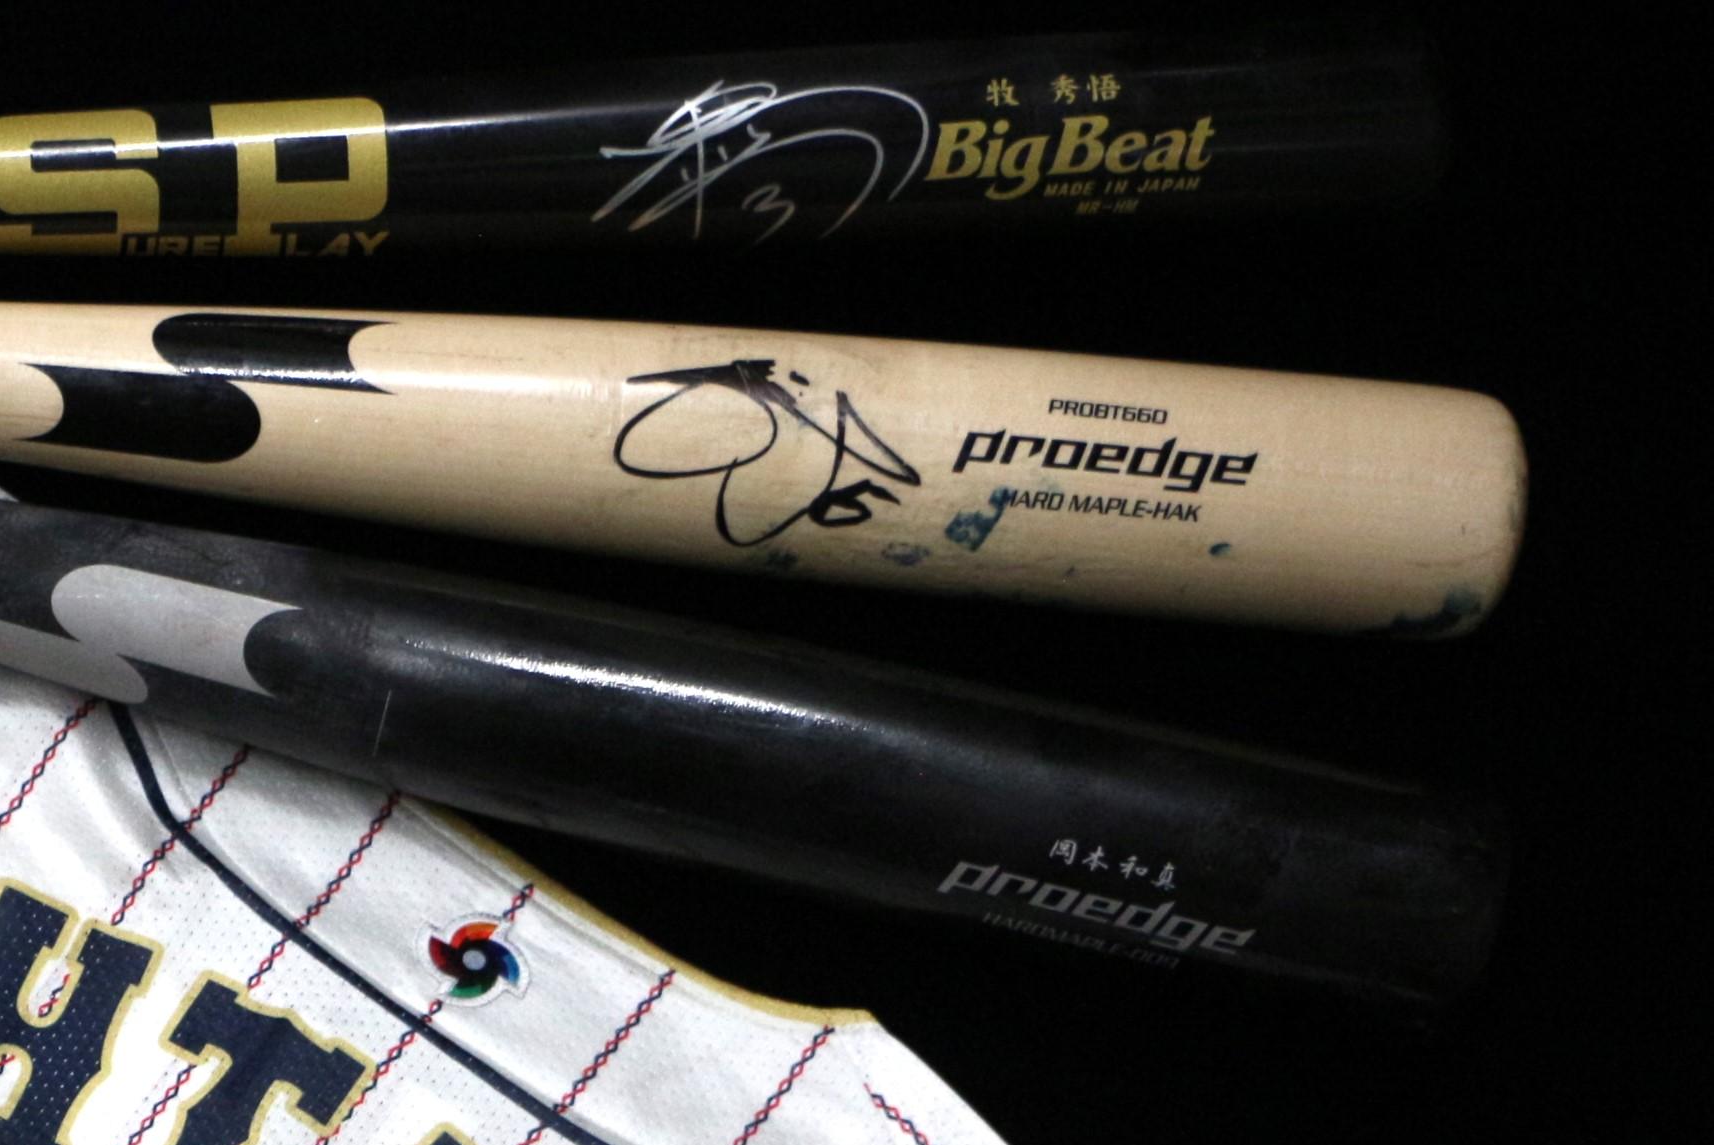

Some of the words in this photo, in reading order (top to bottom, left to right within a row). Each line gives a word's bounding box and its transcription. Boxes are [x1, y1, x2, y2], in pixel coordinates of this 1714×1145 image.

[1042, 179, 1094, 198] MADE
[1104, 179, 1130, 194] IN
[1137, 176, 1200, 194] JAPAN
[951, 428, 1259, 494] proedge
[999, 488, 1065, 513] HARD
[937, 860, 1256, 956] proedge
